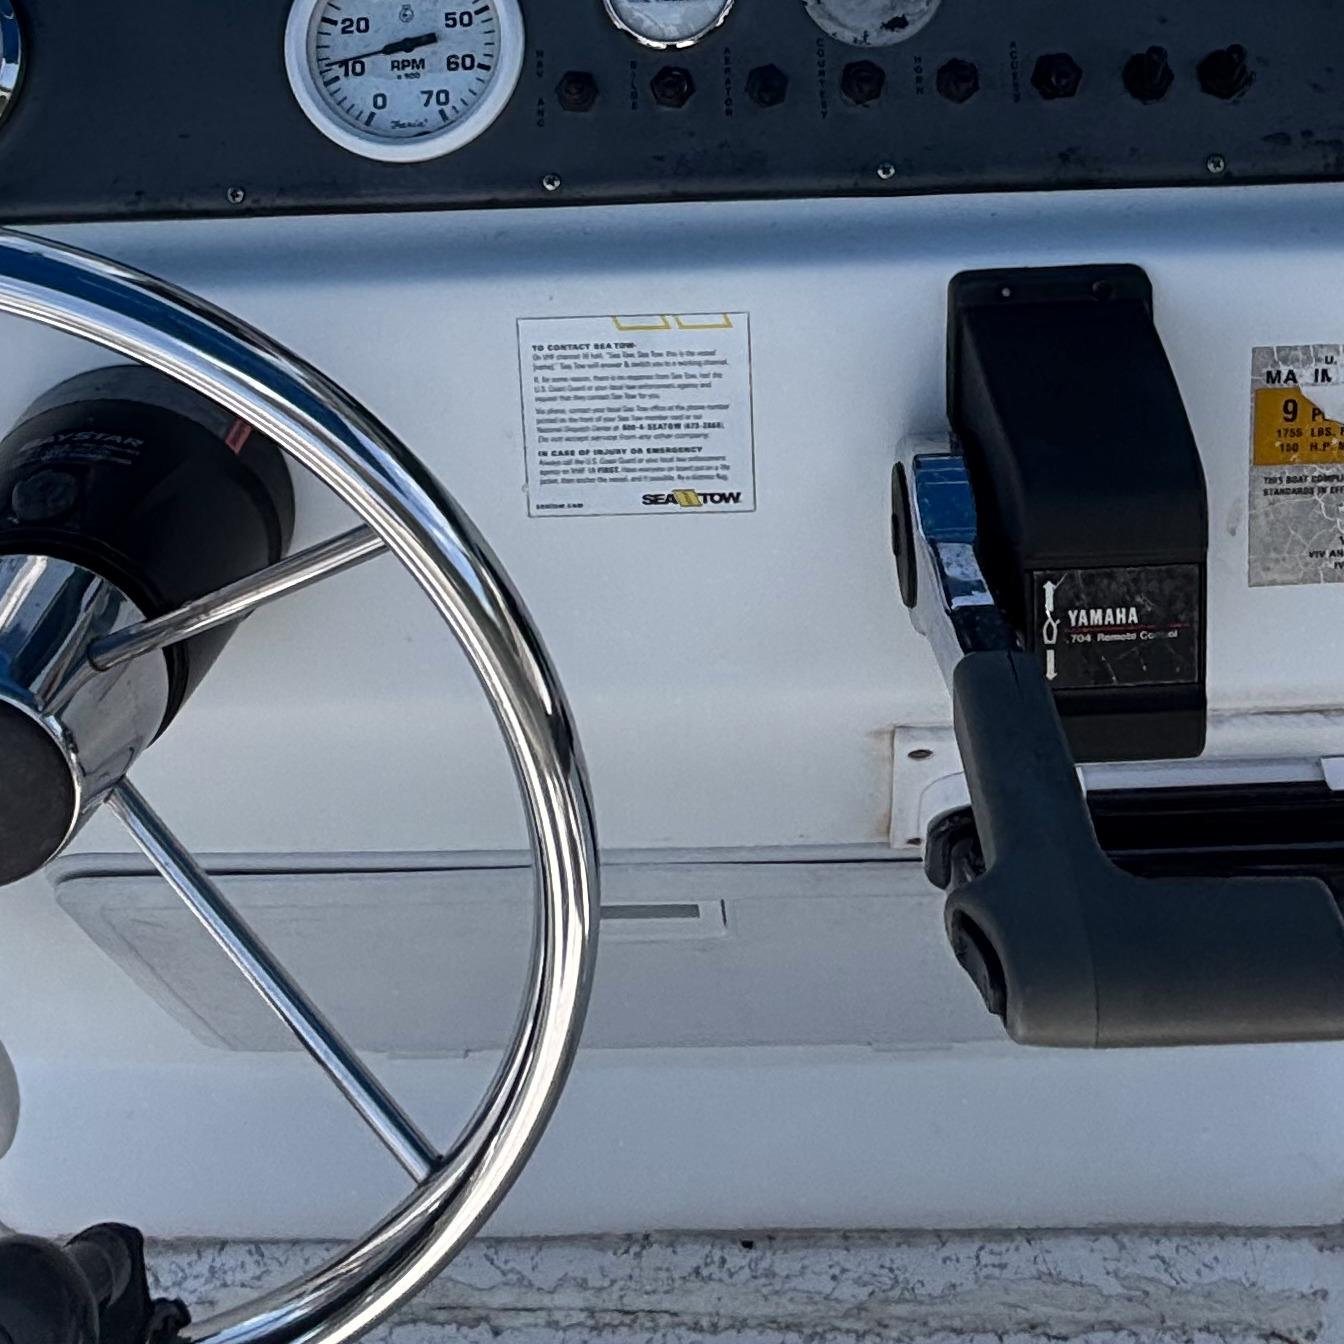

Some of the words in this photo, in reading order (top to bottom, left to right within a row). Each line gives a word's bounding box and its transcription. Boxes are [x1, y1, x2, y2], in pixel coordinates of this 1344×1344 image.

[341, 17, 370, 35] 20
[444, 11, 473, 29] 50
[340, 60, 366, 77] 10
[391, 58, 426, 72] RPM
[446, 54, 475, 72] 60
[723, 48, 733, 117] AERATOR
[816, 38, 828, 119] COURTESY
[914, 56, 924, 95] HORN
[373, 93, 387, 110] 0
[421, 89, 450, 107] 70
[547, 343, 591, 352] CONTACT
[1282, 398, 1299, 424] 9
[551, 449, 575, 457] CASE
[1280, 442, 1299, 453] 150
[1286, 474, 1307, 483] BOAT
[642, 493, 676, 506] SEA
[701, 492, 741, 505] TOW
[1263, 486, 1314, 496] STANDARDS
[1068, 607, 1139, 626] YAMAHA
[1071, 633, 1091, 643] 704
[1097, 632, 1137, 643] Remote
[1140, 630, 1178, 641] Cool
